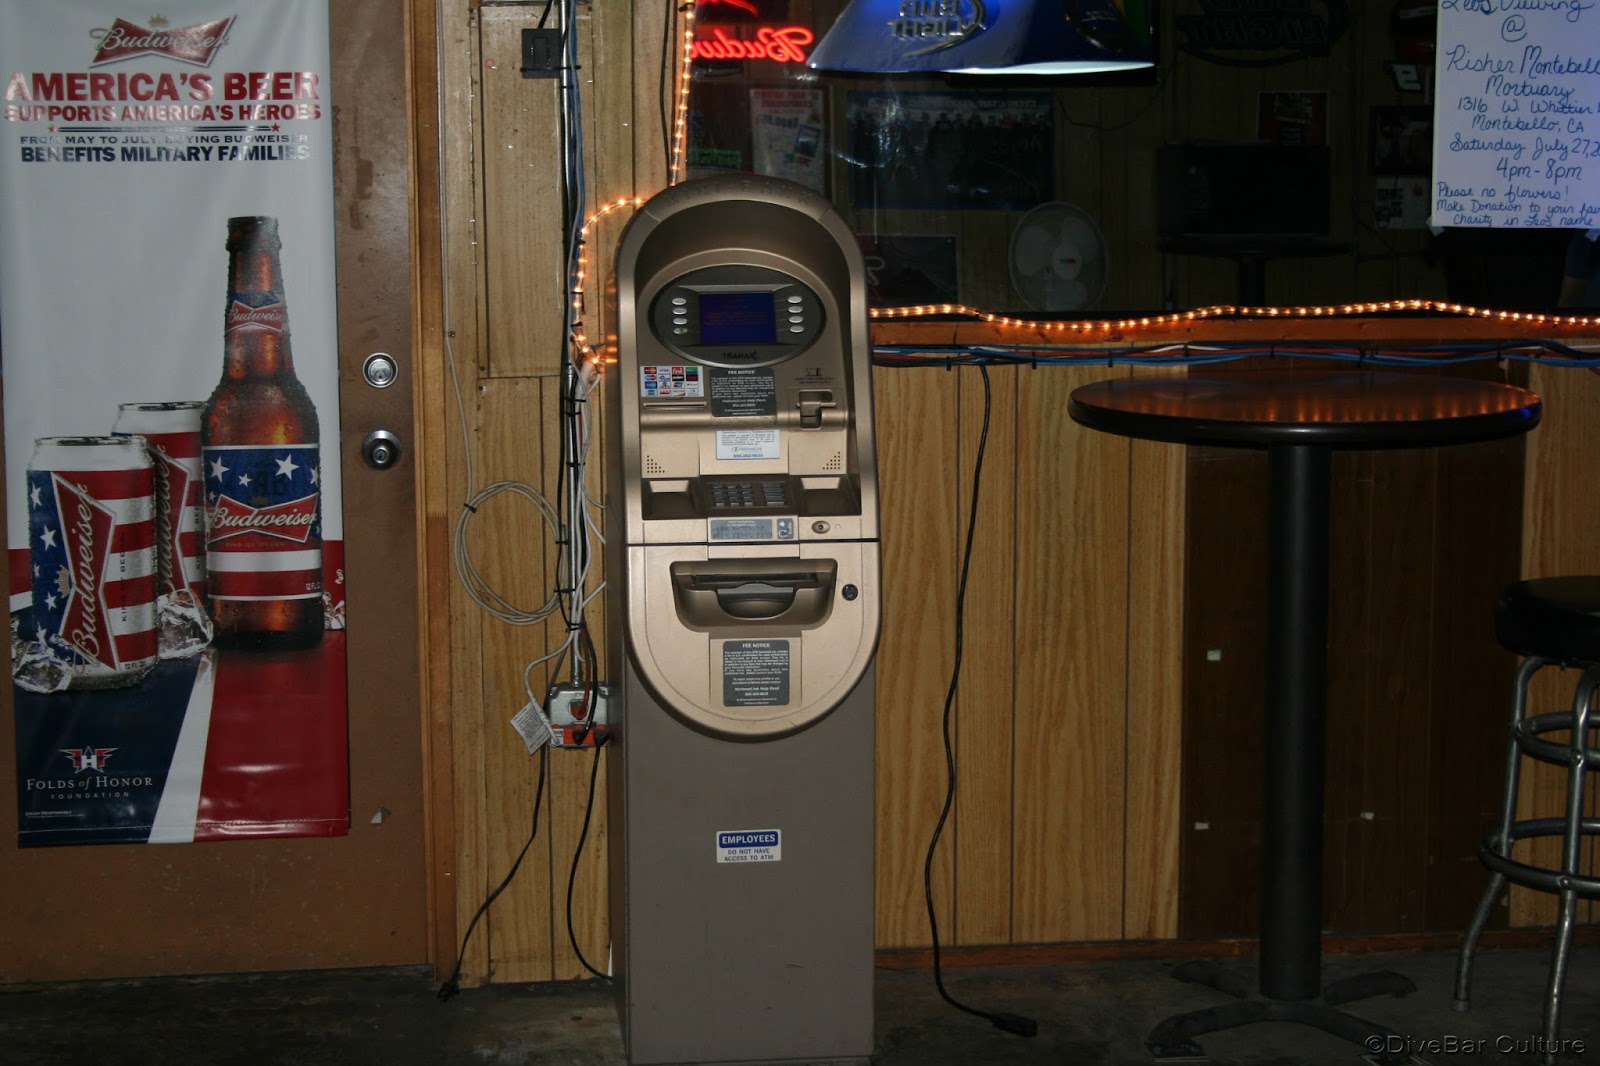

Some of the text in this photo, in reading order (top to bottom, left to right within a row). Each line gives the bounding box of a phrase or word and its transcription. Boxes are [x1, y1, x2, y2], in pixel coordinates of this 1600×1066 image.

[1501, 14, 1528, 43] @
[89, 26, 232, 51] Budweiser
[5, 71, 320, 101] AMERICA'S BEER
[1484, 74, 1576, 106] Mortuary
[5, 103, 322, 122] SUPPORTS AMERICA'S HEROES
[1457, 98, 1488, 113] 1316
[1566, 117, 1585, 134] CA
[65, 135, 96, 145] MAY
[99, 135, 118, 145] TO
[1449, 132, 1527, 161] Saturday
[1532, 136, 1569, 162] July
[20, 144, 311, 163] BENEFITS MILITARY FAMILIES
[1437, 181, 1474, 198] Please
[1480, 187, 1497, 198] no
[1436, 199, 1466, 213] Make
[1470, 198, 1522, 212] Donation
[1528, 201, 1541, 213] to
[1546, 205, 1574, 218] your
[1452, 212, 1494, 229] Charity
[1502, 214, 1519, 227] in
[1558, 213, 1594, 228] name
[207, 505, 319, 529] Budweiser
[71, 481, 103, 675] Budweiser
[26, 775, 153, 791] FOLDS of HONOR
[50, 791, 130, 800] FOUNDATION
[721, 833, 776, 845] EMPLOYEES
